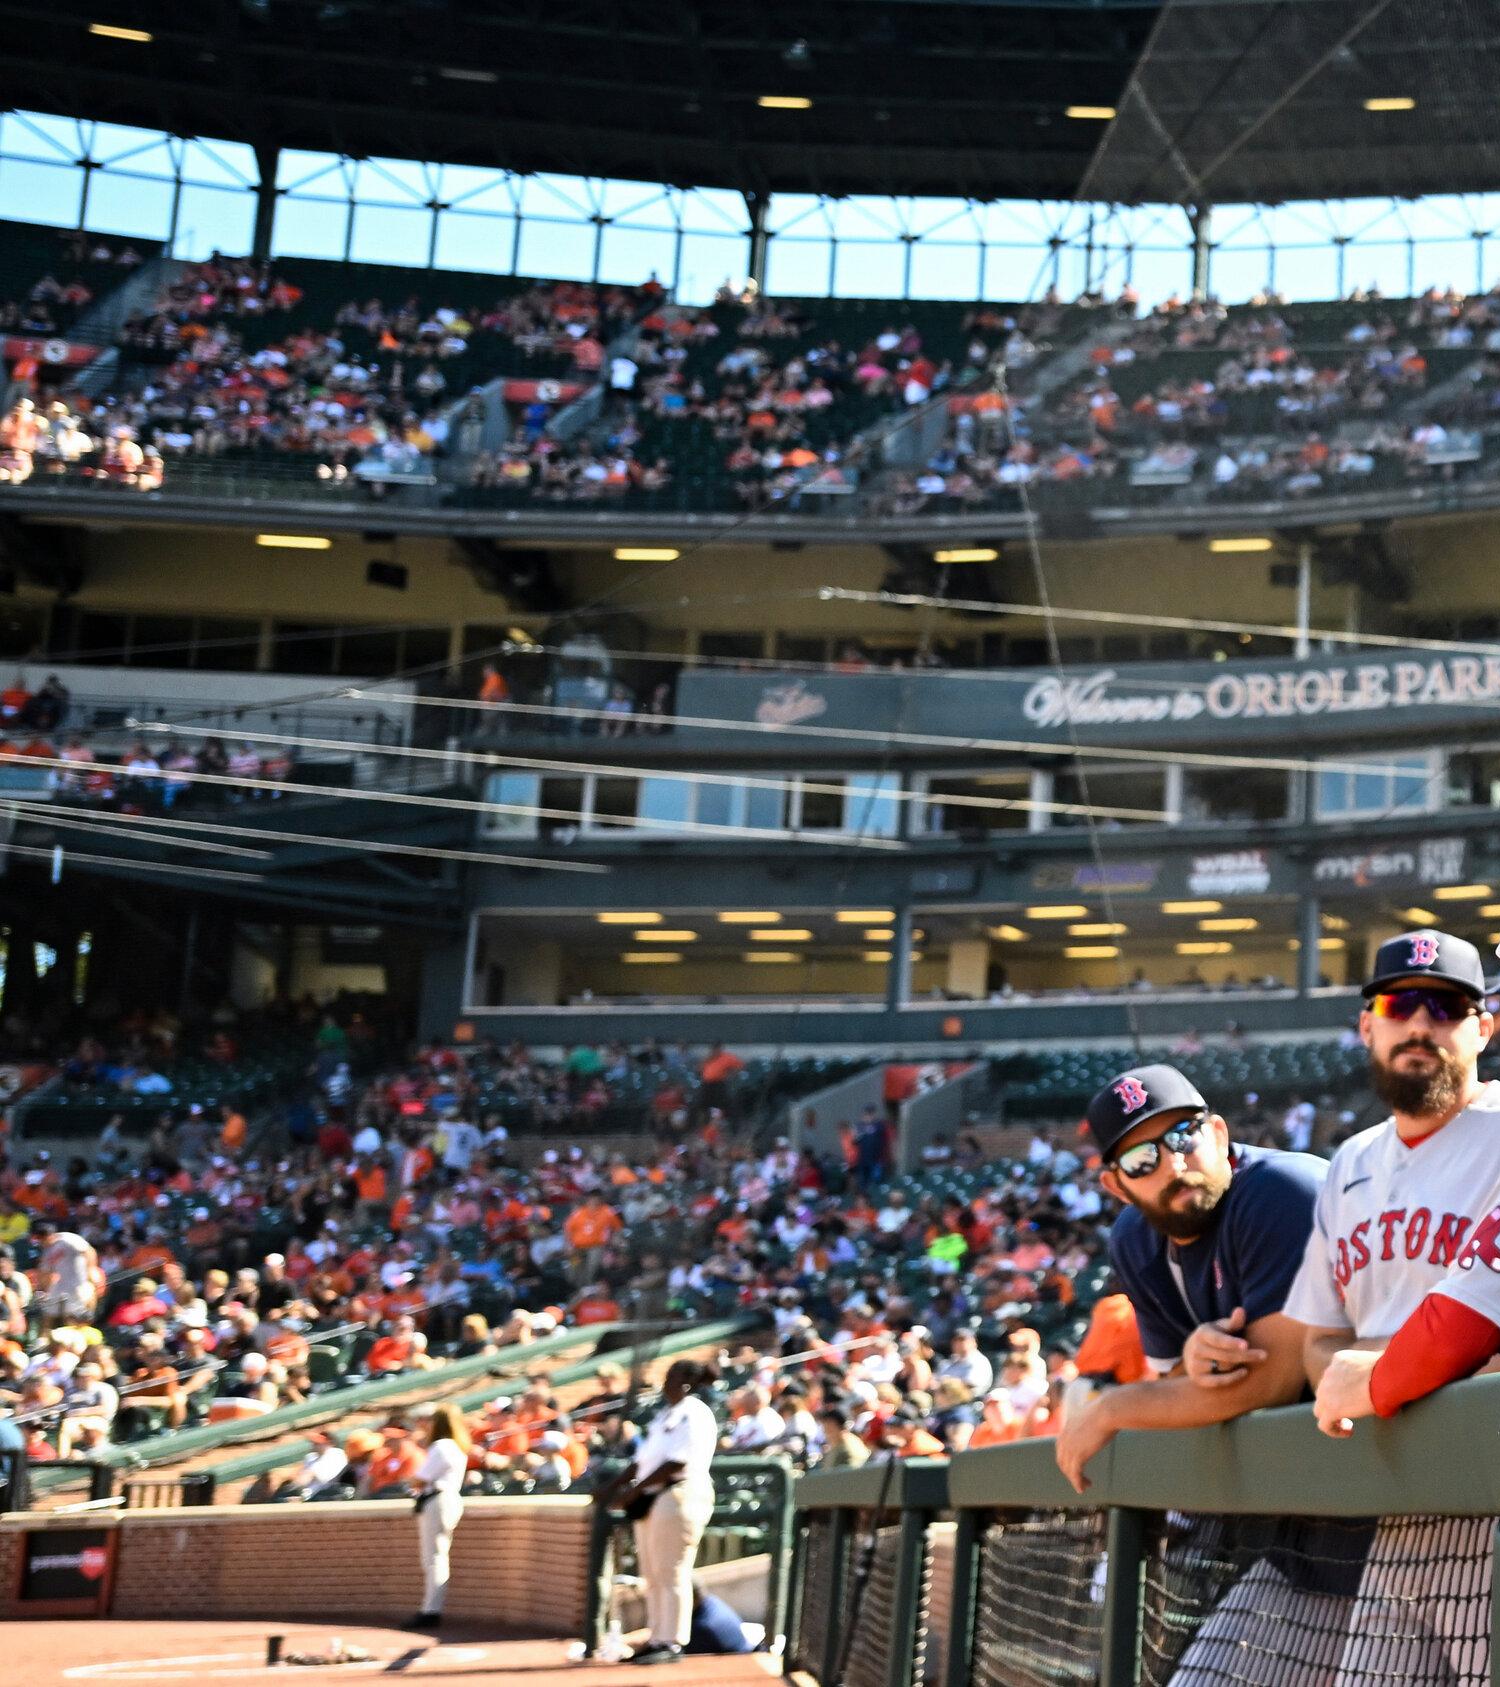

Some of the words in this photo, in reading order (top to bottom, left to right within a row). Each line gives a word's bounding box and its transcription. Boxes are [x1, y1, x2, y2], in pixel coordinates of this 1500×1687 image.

[1022, 668, 1171, 728] Welcome
[1206, 664, 1390, 719] ORIOLE
[1406, 933, 1440, 968] B
[1112, 1076, 1149, 1116] B
